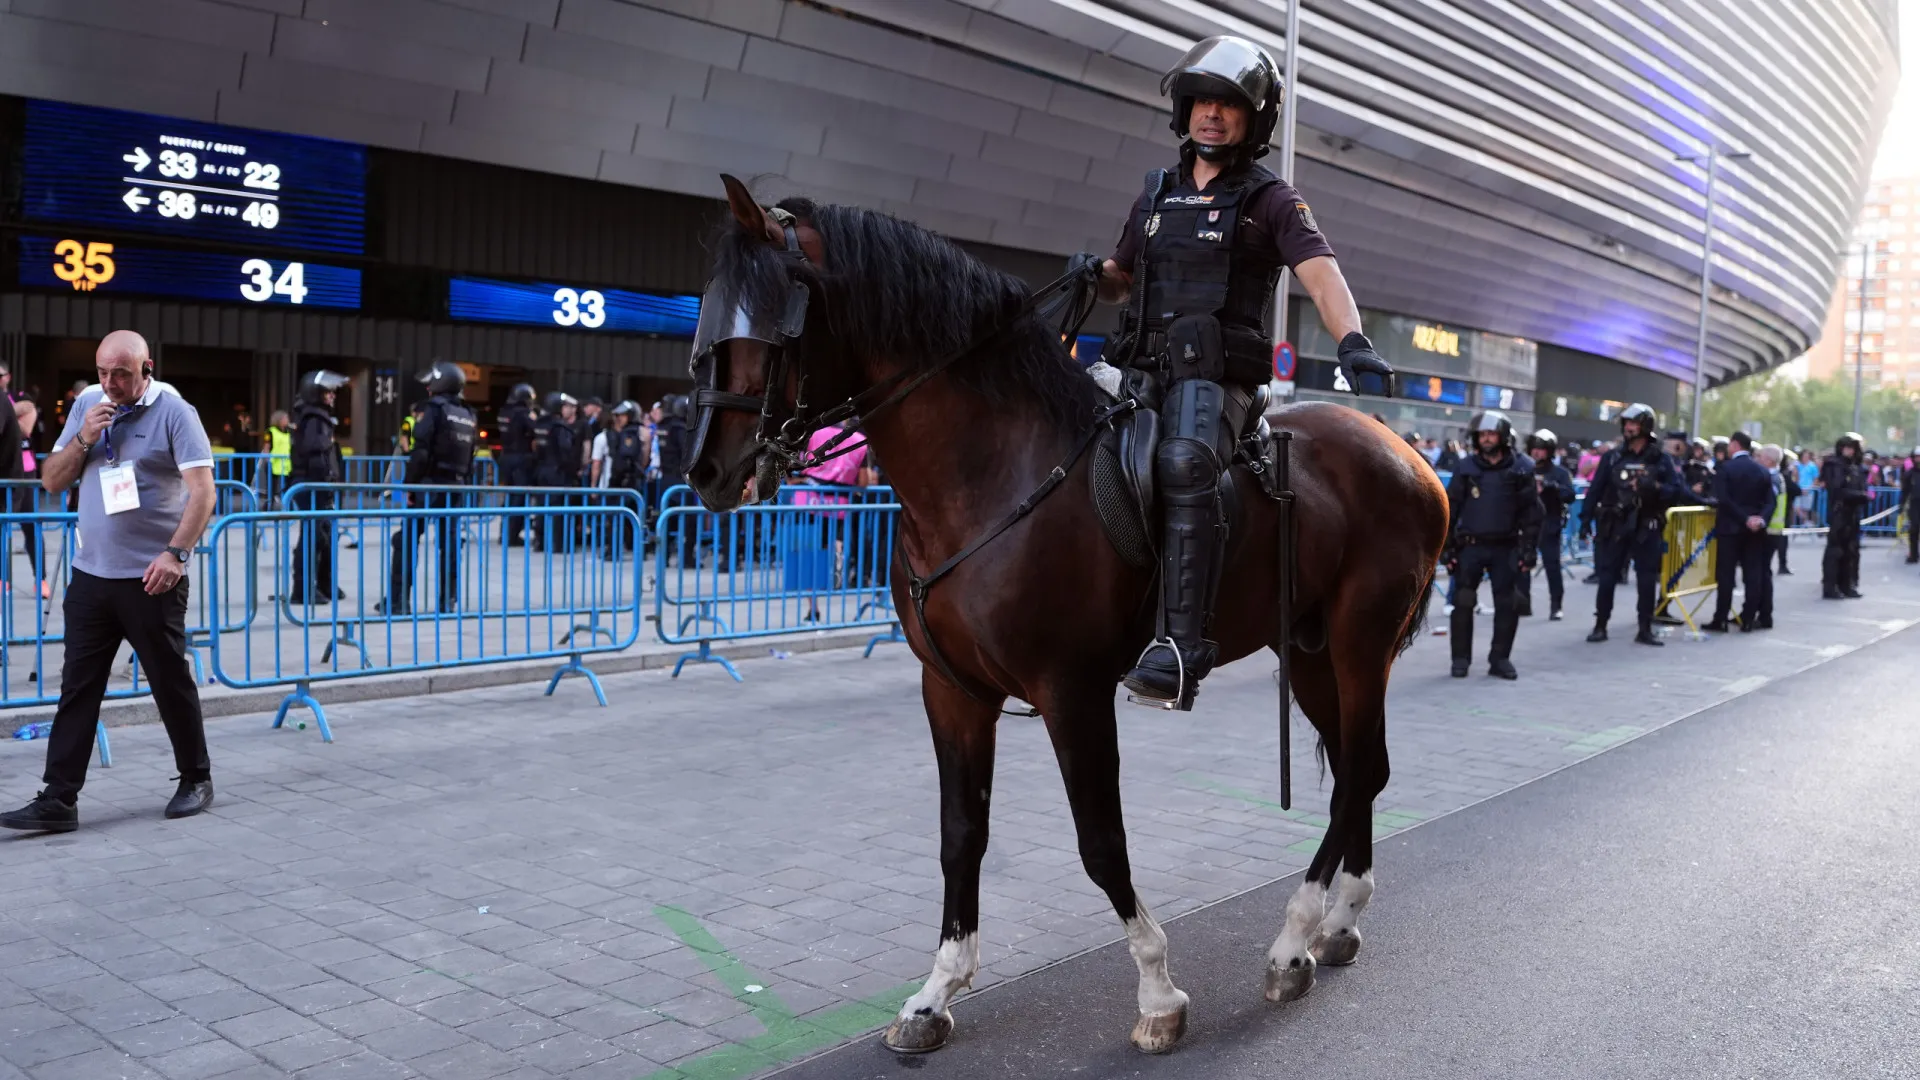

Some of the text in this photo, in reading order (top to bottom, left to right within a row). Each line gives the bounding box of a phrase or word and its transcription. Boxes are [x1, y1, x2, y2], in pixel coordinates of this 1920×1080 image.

[160, 135, 205, 150] PUERTAS
[214, 143, 246, 155] GATES
[159, 150, 197, 179] 33
[226, 166, 240, 177] TO
[243, 162, 280, 191] 22
[158, 191, 197, 220] 36
[224, 206, 238, 216] TO
[242, 202, 279, 229] 49
[54, 239, 115, 283] 35
[240, 259, 308, 303] 34
[72, 279, 97, 291] VIP
[553, 288, 606, 328] 33
